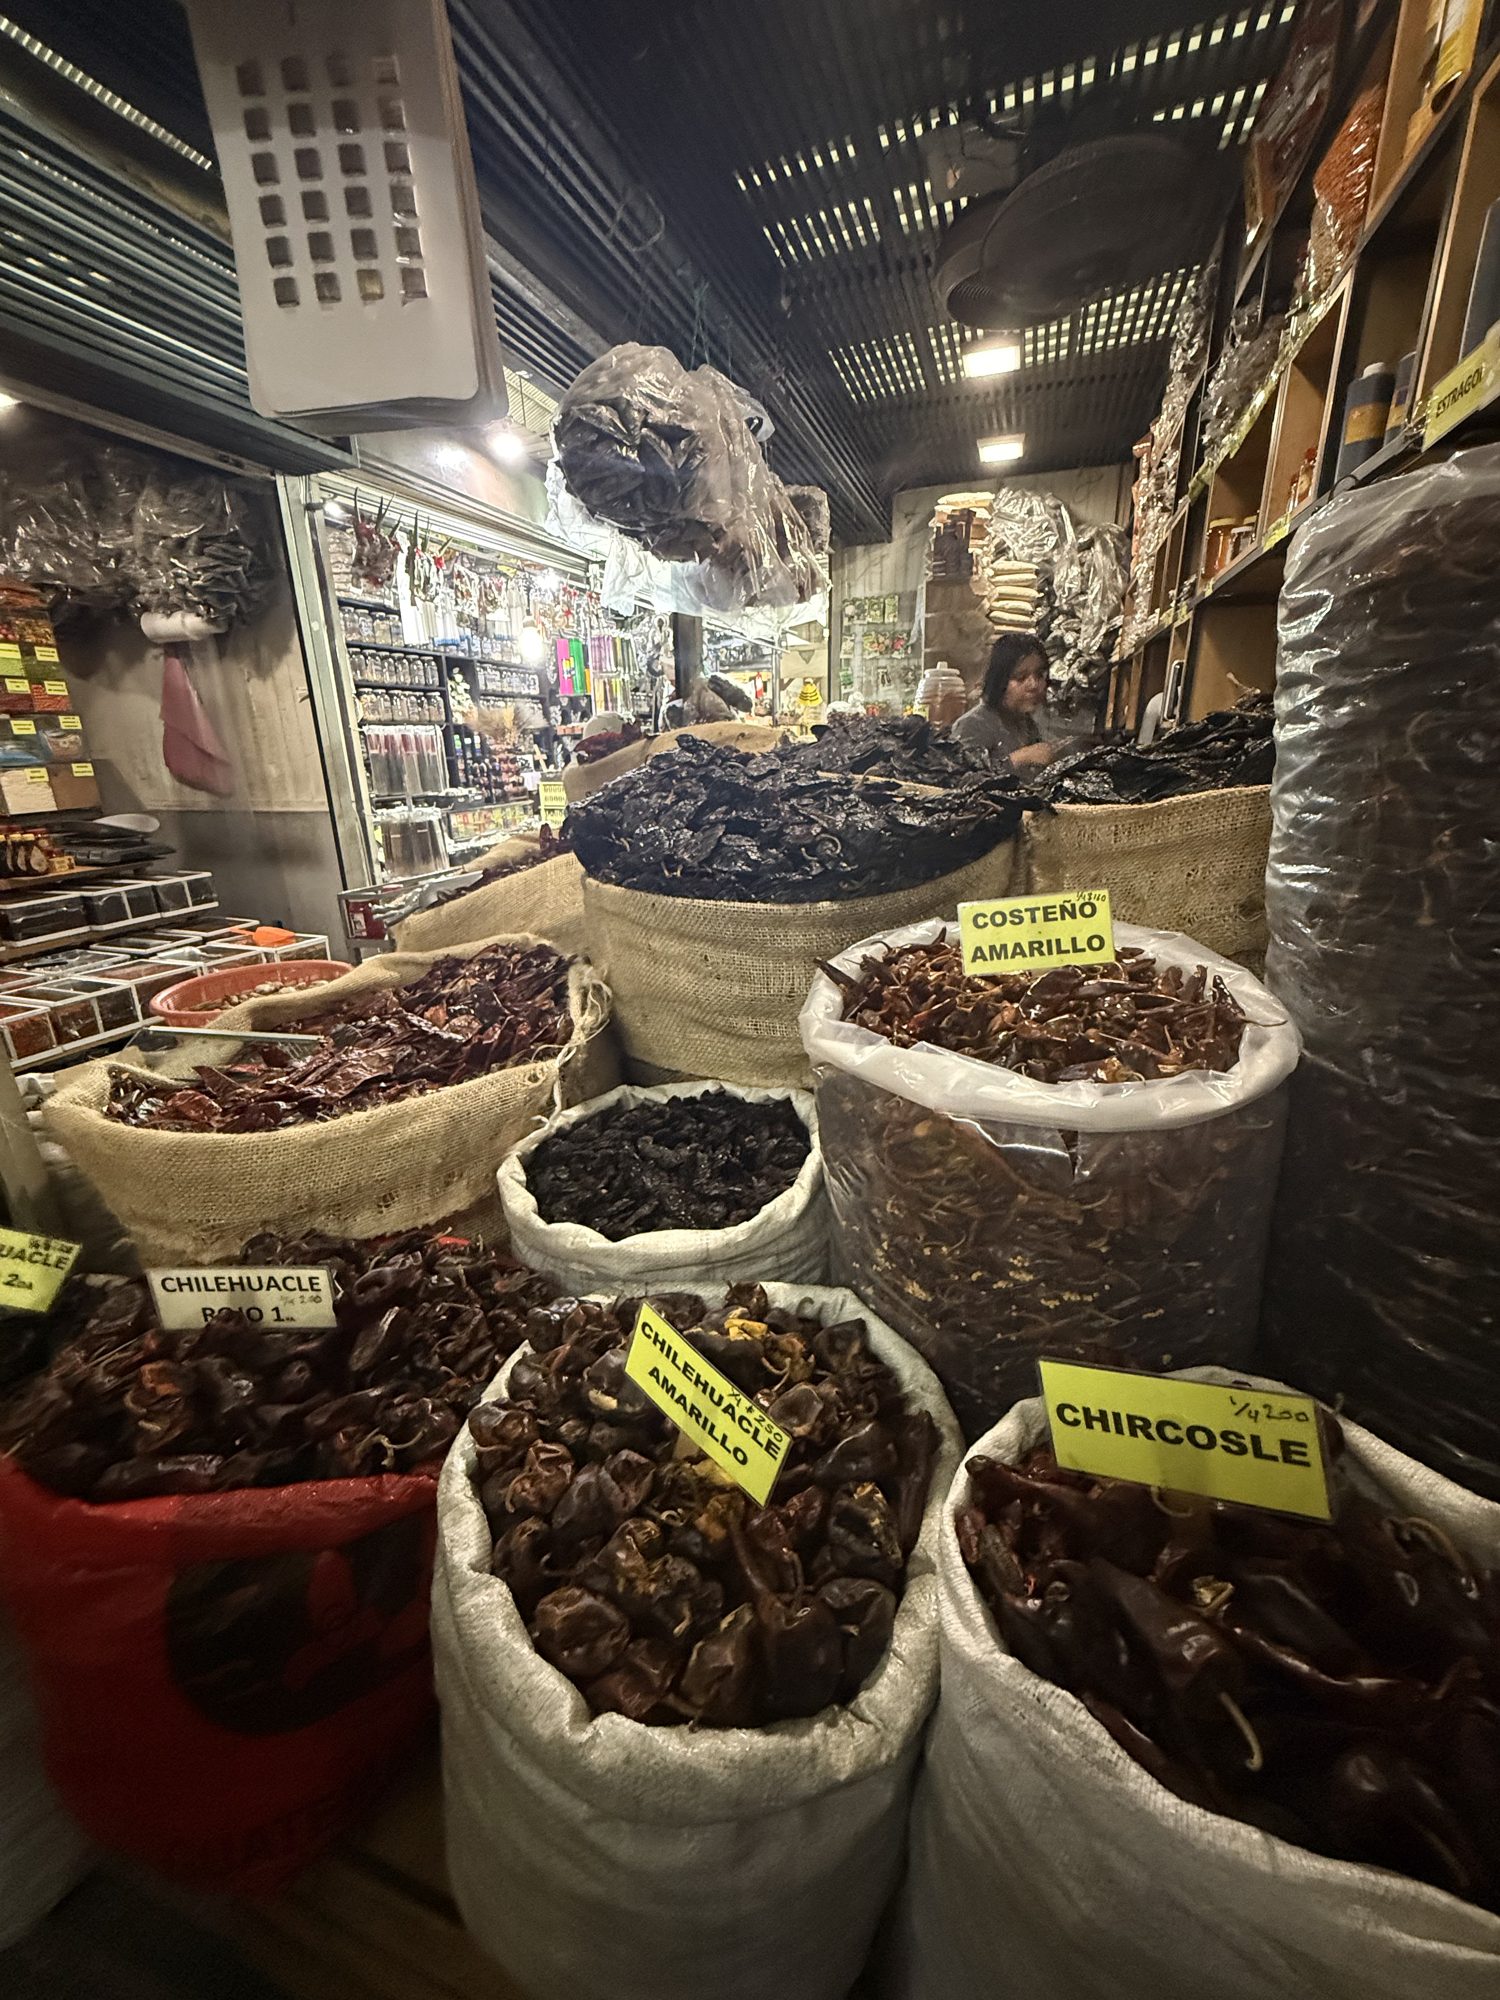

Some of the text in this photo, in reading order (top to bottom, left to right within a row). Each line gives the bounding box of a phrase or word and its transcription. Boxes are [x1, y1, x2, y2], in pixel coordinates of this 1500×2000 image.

[1436, 366, 1483, 418] ESTRAGO
[972, 899, 1098, 930] COSTEÑO
[971, 934, 1106, 963] AMARILLO
[160, 1275, 322, 1293] CHILEHUACLE
[201, 1306, 264, 1322] RO
[641, 1321, 781, 1461] CHILEHUACLE
[648, 1366, 749, 1466] AMARILLO
[1055, 1402, 1312, 1468] CHIRCOSLE
